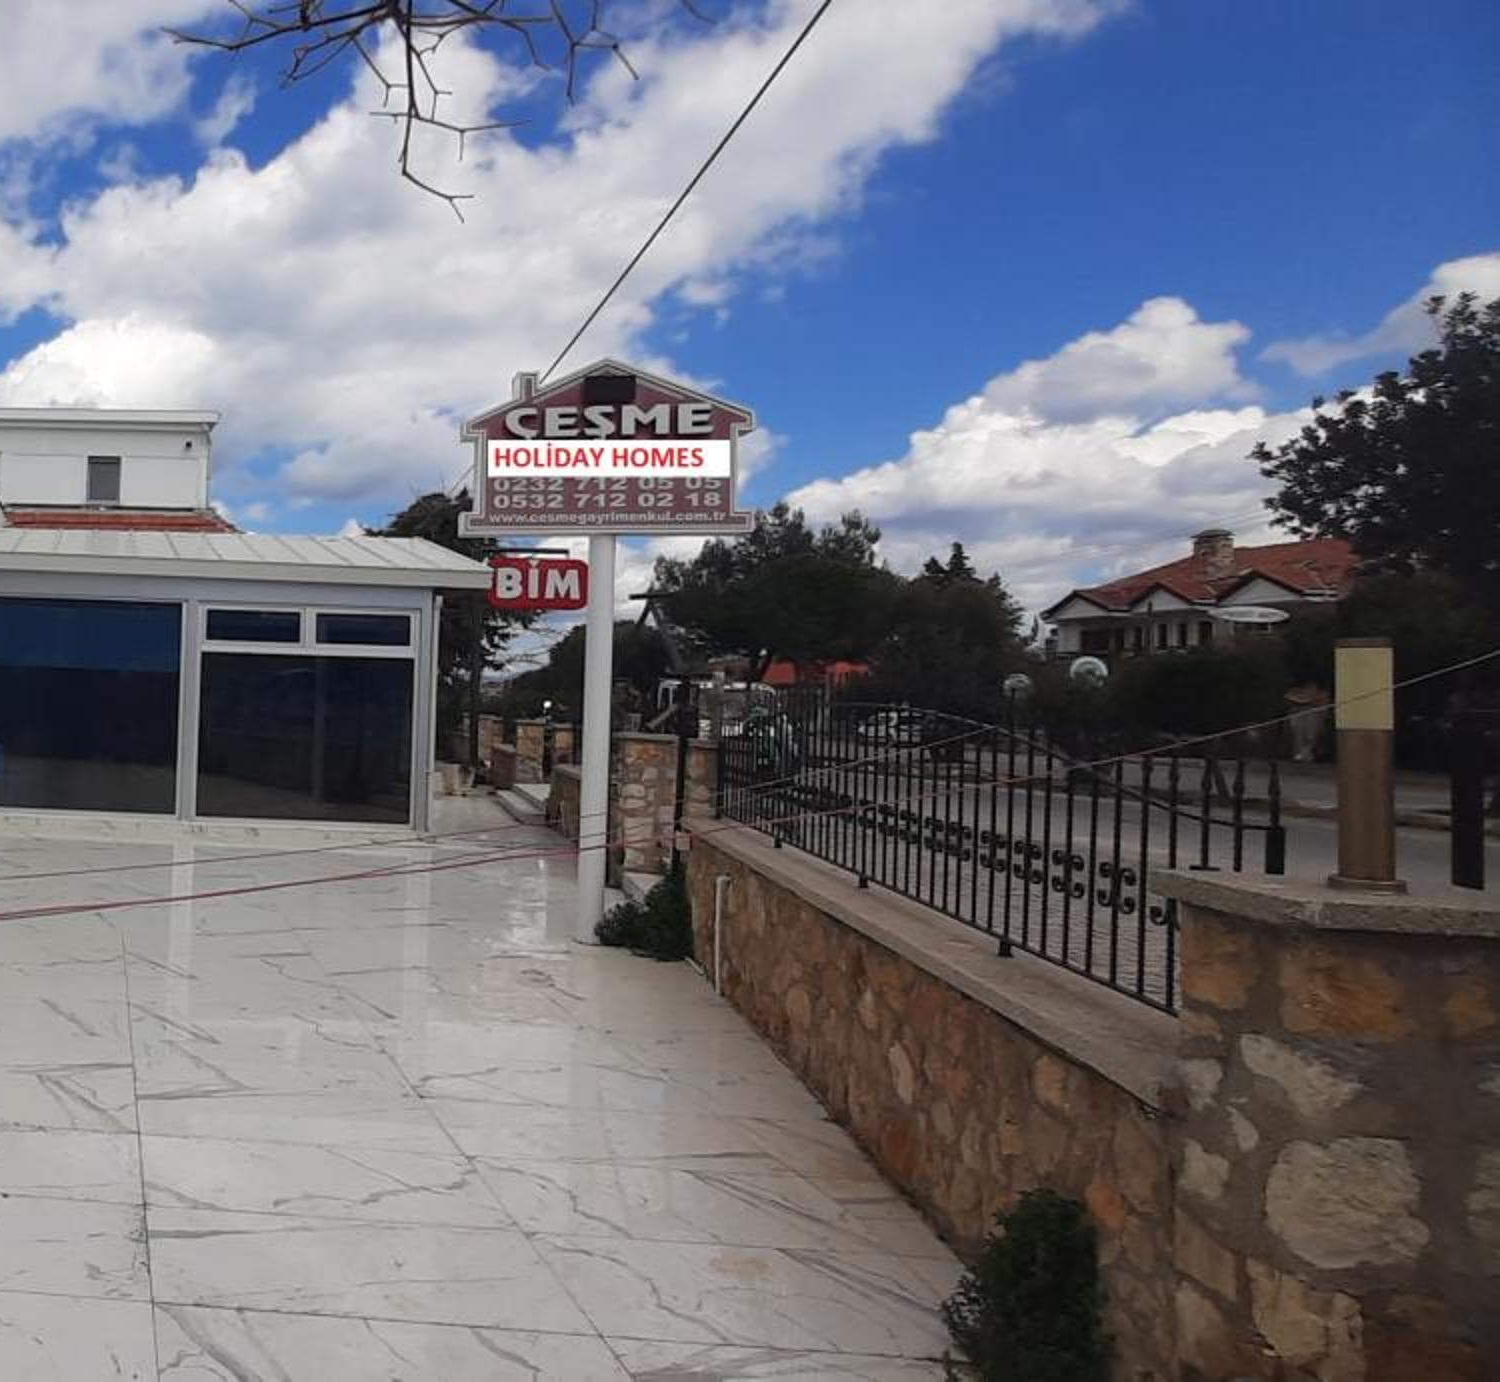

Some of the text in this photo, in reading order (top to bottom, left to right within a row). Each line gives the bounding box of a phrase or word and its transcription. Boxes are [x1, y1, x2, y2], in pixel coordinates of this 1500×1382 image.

[505, 403, 714, 440] ÇEŞME
[493, 477, 564, 492] 0232
[575, 477, 627, 491] 712
[493, 492, 721, 508] 0532 712 02 18
[489, 511, 726, 524] www.cesmegayrimenkul.com.tr
[496, 560, 581, 600] BİM
